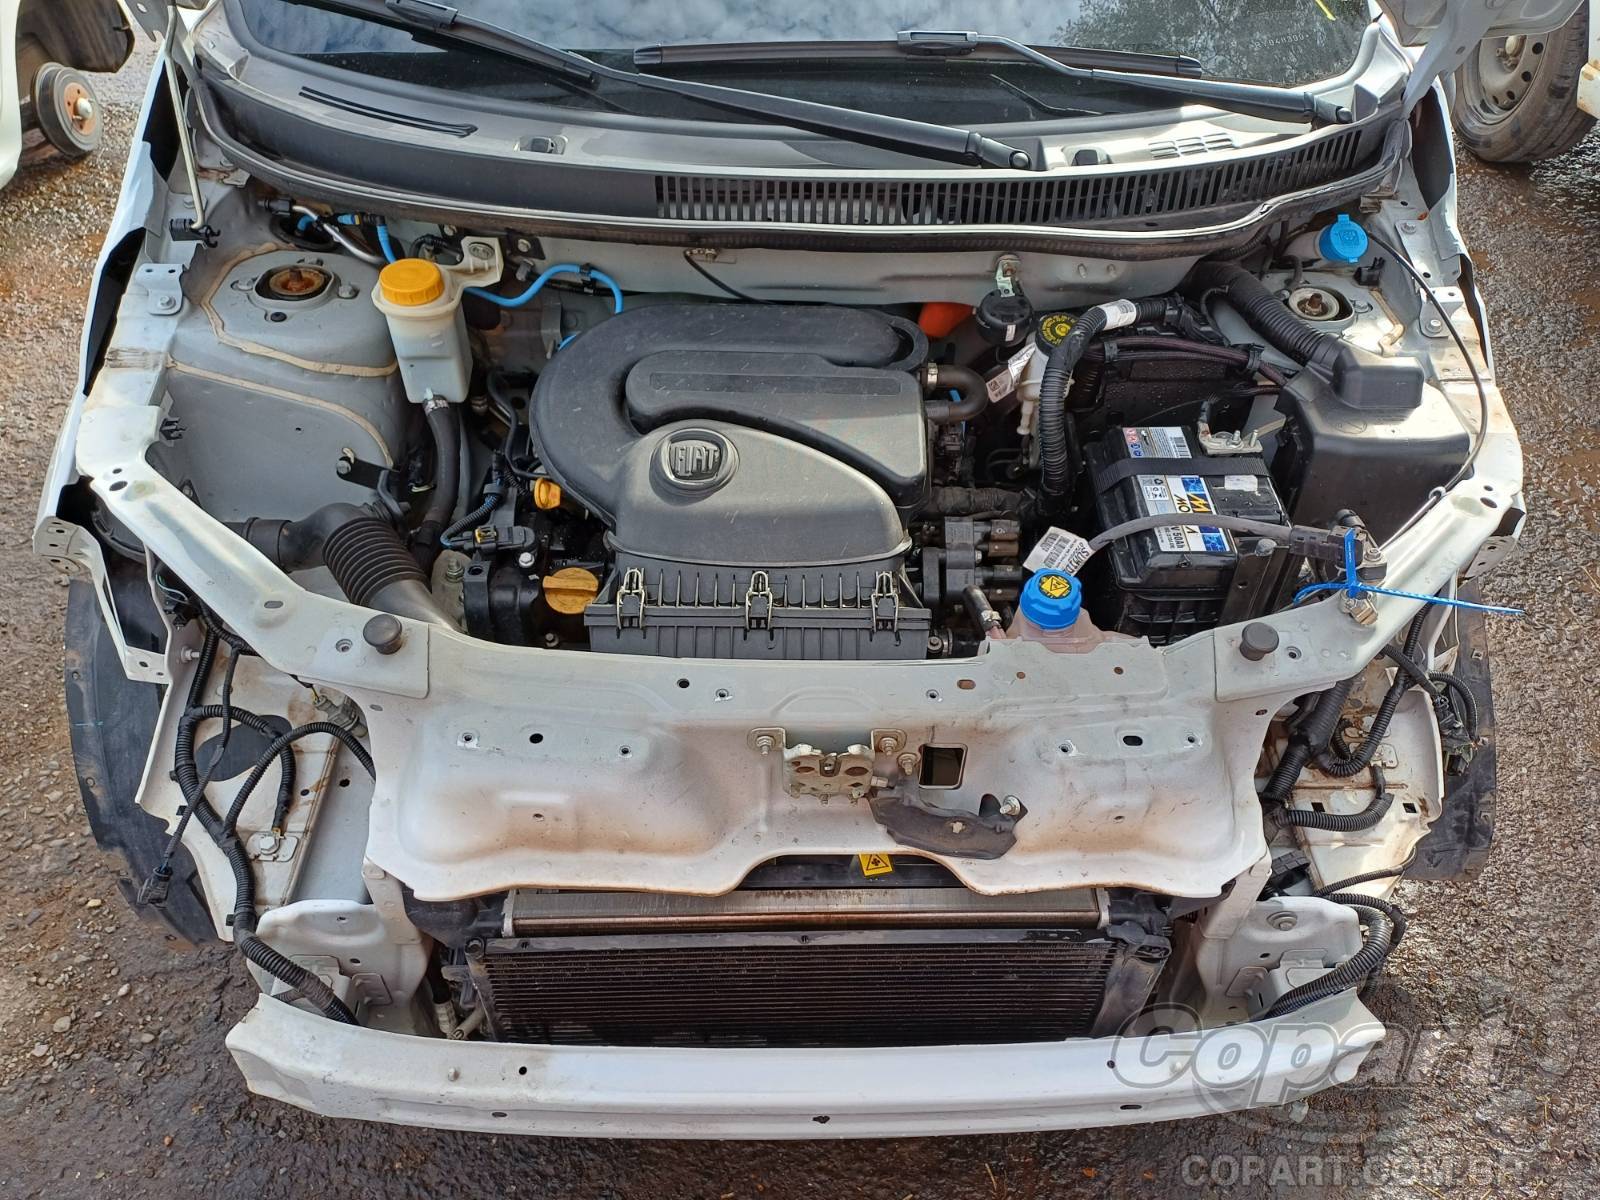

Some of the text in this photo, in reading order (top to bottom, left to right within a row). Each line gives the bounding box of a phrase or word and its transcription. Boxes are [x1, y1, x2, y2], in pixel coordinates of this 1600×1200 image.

[671, 446, 720, 474] FIAT
[1173, 493, 1199, 534] MOA
[1173, 532, 1185, 549] 50Ah
